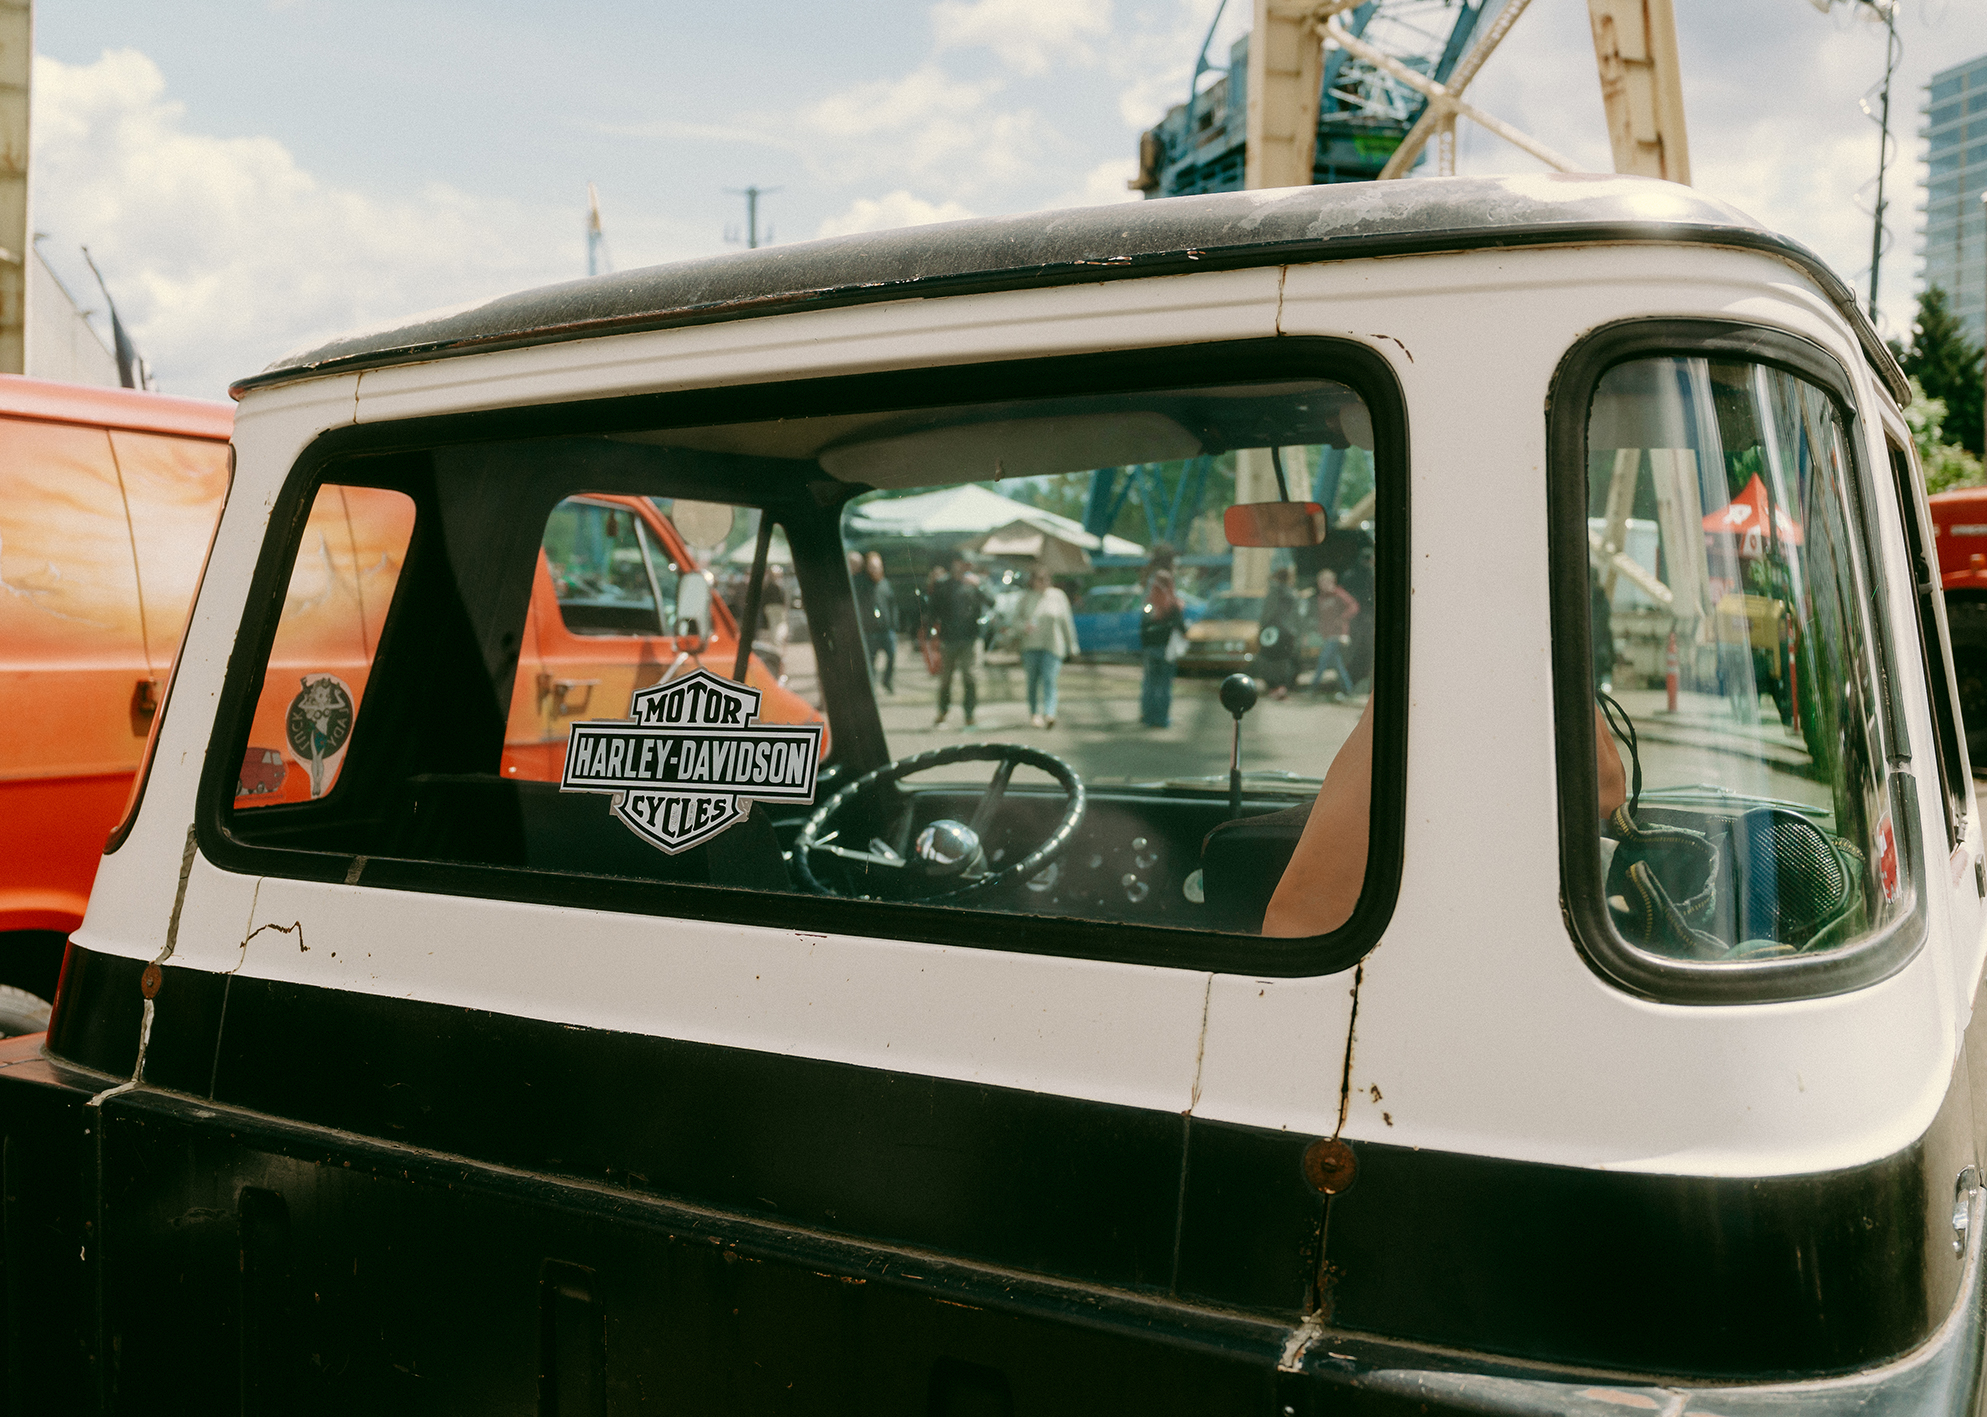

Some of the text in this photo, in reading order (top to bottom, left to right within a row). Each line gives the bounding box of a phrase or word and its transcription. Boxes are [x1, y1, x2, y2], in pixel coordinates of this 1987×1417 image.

[644, 681, 742, 724] MOTOR
[575, 737, 807, 784] HARLEY-DAVIDSON
[631, 795, 728, 838] CYCLES
